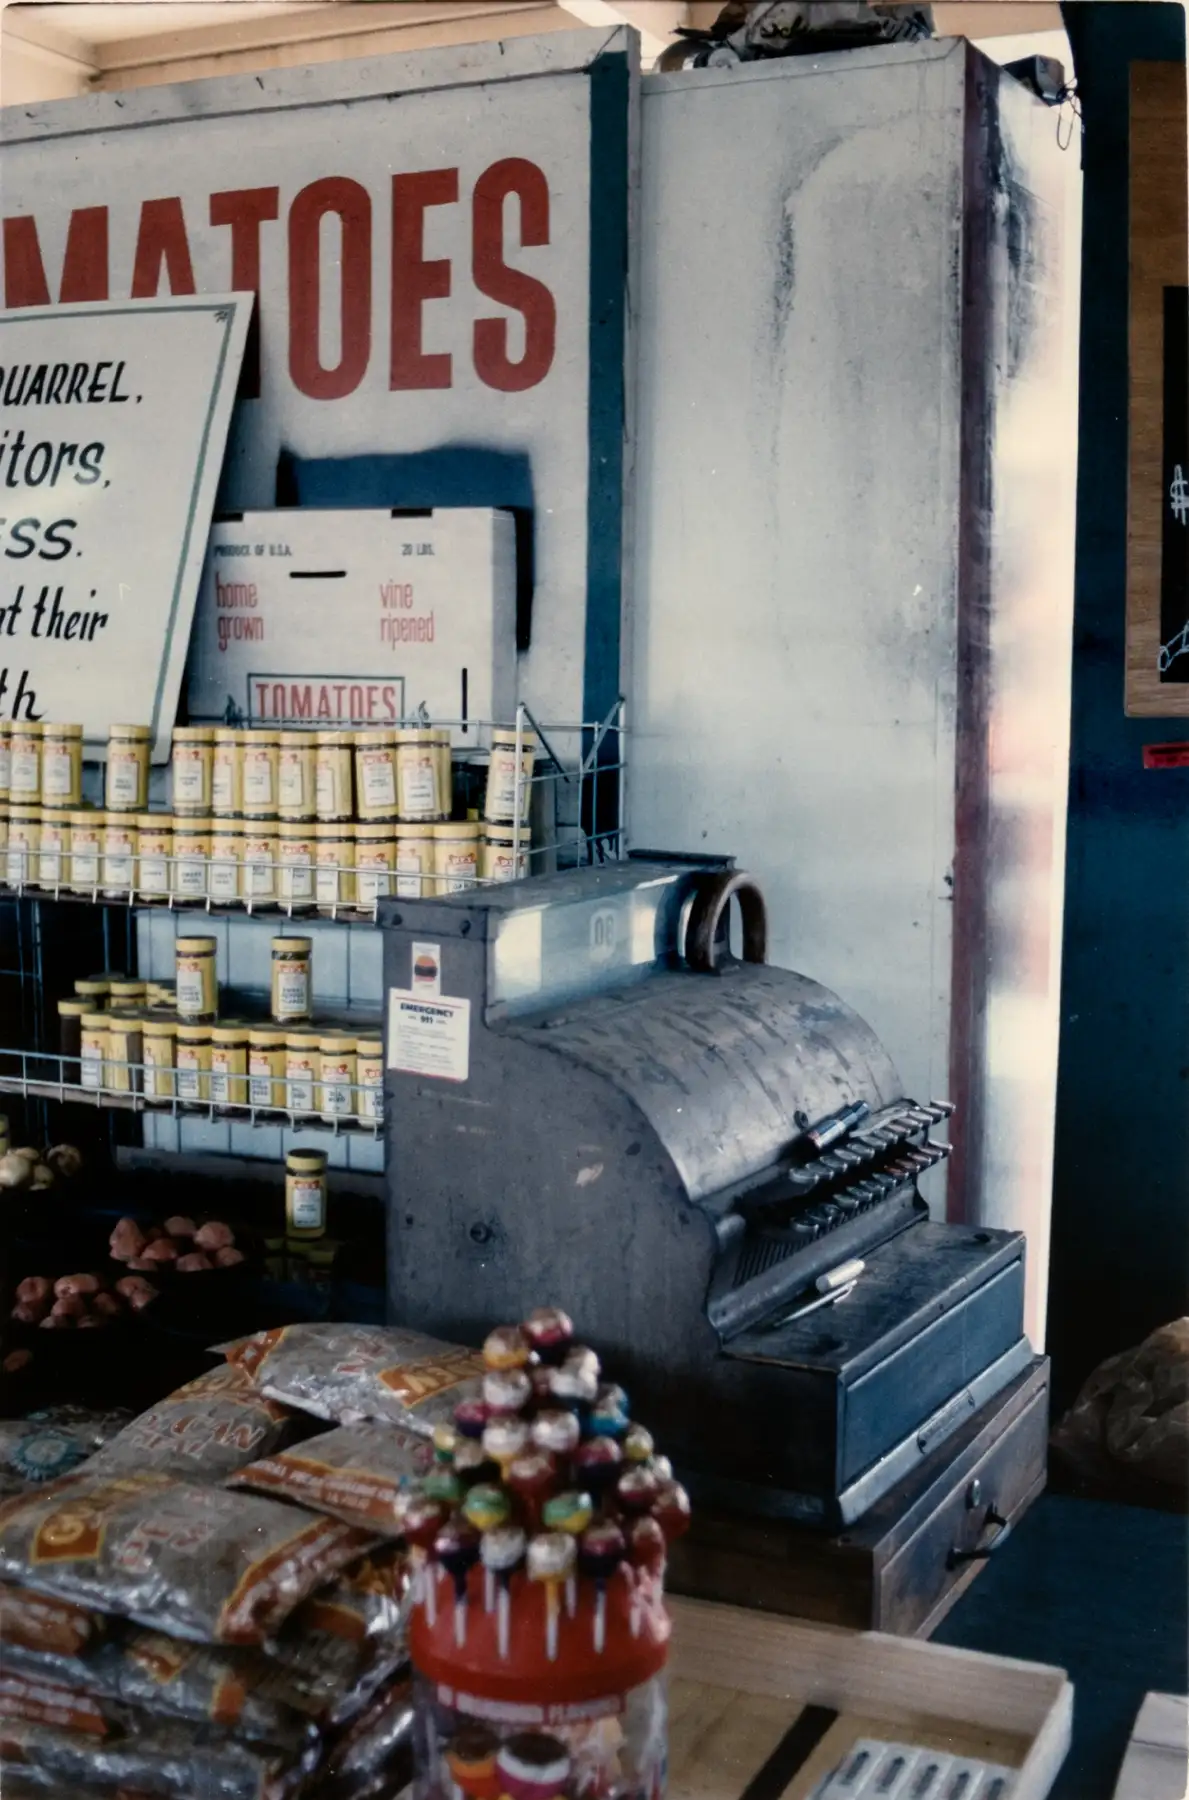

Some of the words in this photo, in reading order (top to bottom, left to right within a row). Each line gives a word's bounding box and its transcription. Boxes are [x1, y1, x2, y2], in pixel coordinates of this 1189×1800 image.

[0, 361, 143, 406] UARREL.
[401, 543, 413, 557] 20
[215, 572, 258, 608] home
[380, 580, 413, 609] vine
[31, 585, 109, 641] their
[218, 616, 264, 651] grown
[380, 612, 435, 651] ripened
[255, 684, 397, 727] TOMATOES
[400, 1002, 454, 1017] EMERGENCY
[420, 1016, 433, 1024] 911
